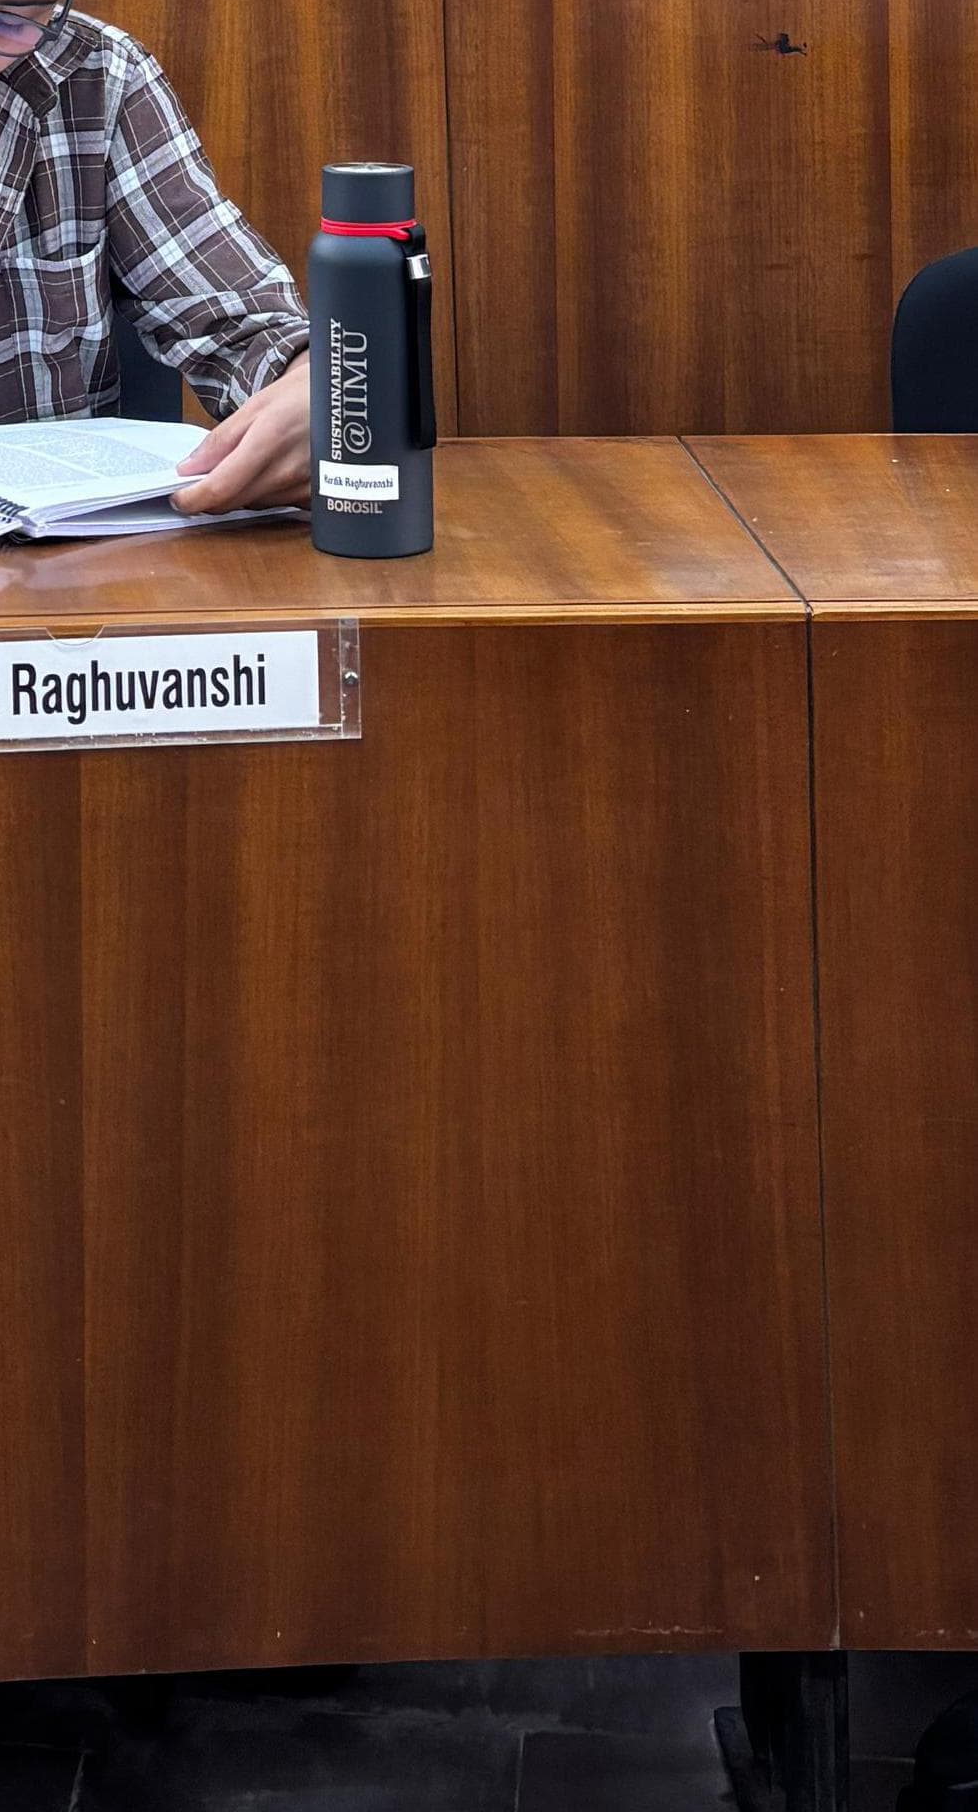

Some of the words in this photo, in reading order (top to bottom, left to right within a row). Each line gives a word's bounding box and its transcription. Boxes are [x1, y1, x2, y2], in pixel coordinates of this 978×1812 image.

[330, 317, 342, 461] SUSTAINABILITY
[342, 328, 372, 455] @IIMU
[327, 498, 383, 514] BOROSIL
[12, 653, 266, 725] Raghuvanshi
